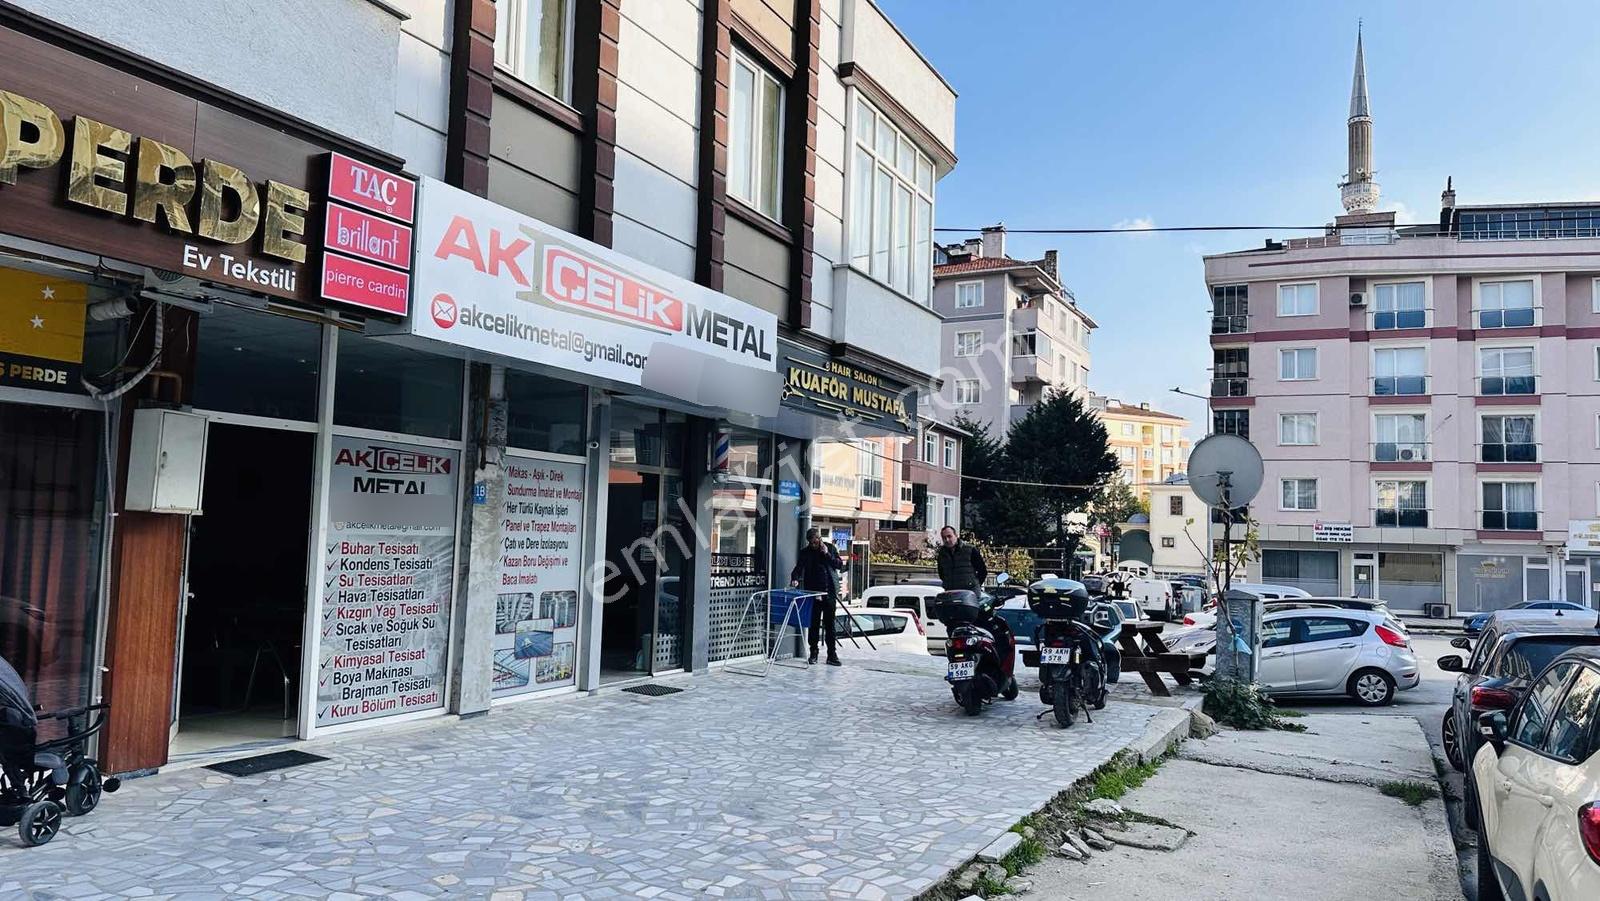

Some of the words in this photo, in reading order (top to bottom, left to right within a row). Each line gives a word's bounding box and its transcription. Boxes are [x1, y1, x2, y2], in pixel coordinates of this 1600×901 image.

[0, 89, 310, 264] PERDE
[337, 212, 400, 260] brillant
[183, 242, 212, 271] Ev
[220, 252, 297, 292] Tekstili
[326, 268, 364, 289] pierre
[368, 280, 406, 298] cardin
[434, 215, 532, 287] AK
[687, 304, 772, 361] METAL
[9, 363, 68, 385] PERDE
[831, 362, 850, 378] HAIR
[853, 371, 878, 386] SALON
[790, 367, 848, 400] KUAFÖR
[853, 387, 907, 418] MUSTAFA
[335, 448, 373, 468] AK
[506, 502, 518, 514] Her
[505, 520, 522, 532] Panel
[341, 541, 375, 555] Buhar
[378, 542, 419, 555] Tesisatı
[526, 537, 539, 549] Dere
[340, 558, 390, 571] Kondens
[393, 558, 433, 570] Tesisatı
[339, 573, 354, 587] Su
[358, 573, 413, 586] Tesisatları
[710, 575, 735, 588] TREND
[338, 590, 366, 603] Hava
[371, 588, 425, 602] Tesisatları
[337, 606, 372, 621] Kızgın
[375, 603, 396, 619] Yağ
[400, 602, 439, 616] Tesisatı
[336, 622, 367, 636] Sıcak
[371, 623, 383, 633] ve
[386, 618, 419, 634] Soğuk
[422, 617, 436, 630] Su
[345, 636, 402, 652] Tesisatları
[334, 651, 385, 669] Kimyasal
[389, 648, 426, 663] Tesisat
[333, 671, 362, 687] Boya
[365, 666, 413, 683] Makinası
[342, 683, 388, 701] Brajman
[392, 677, 432, 694] Tesisatı
[331, 704, 359, 719] Kuru
[362, 698, 396, 714] Bölüm
[400, 691, 438, 707] Tesisatı
